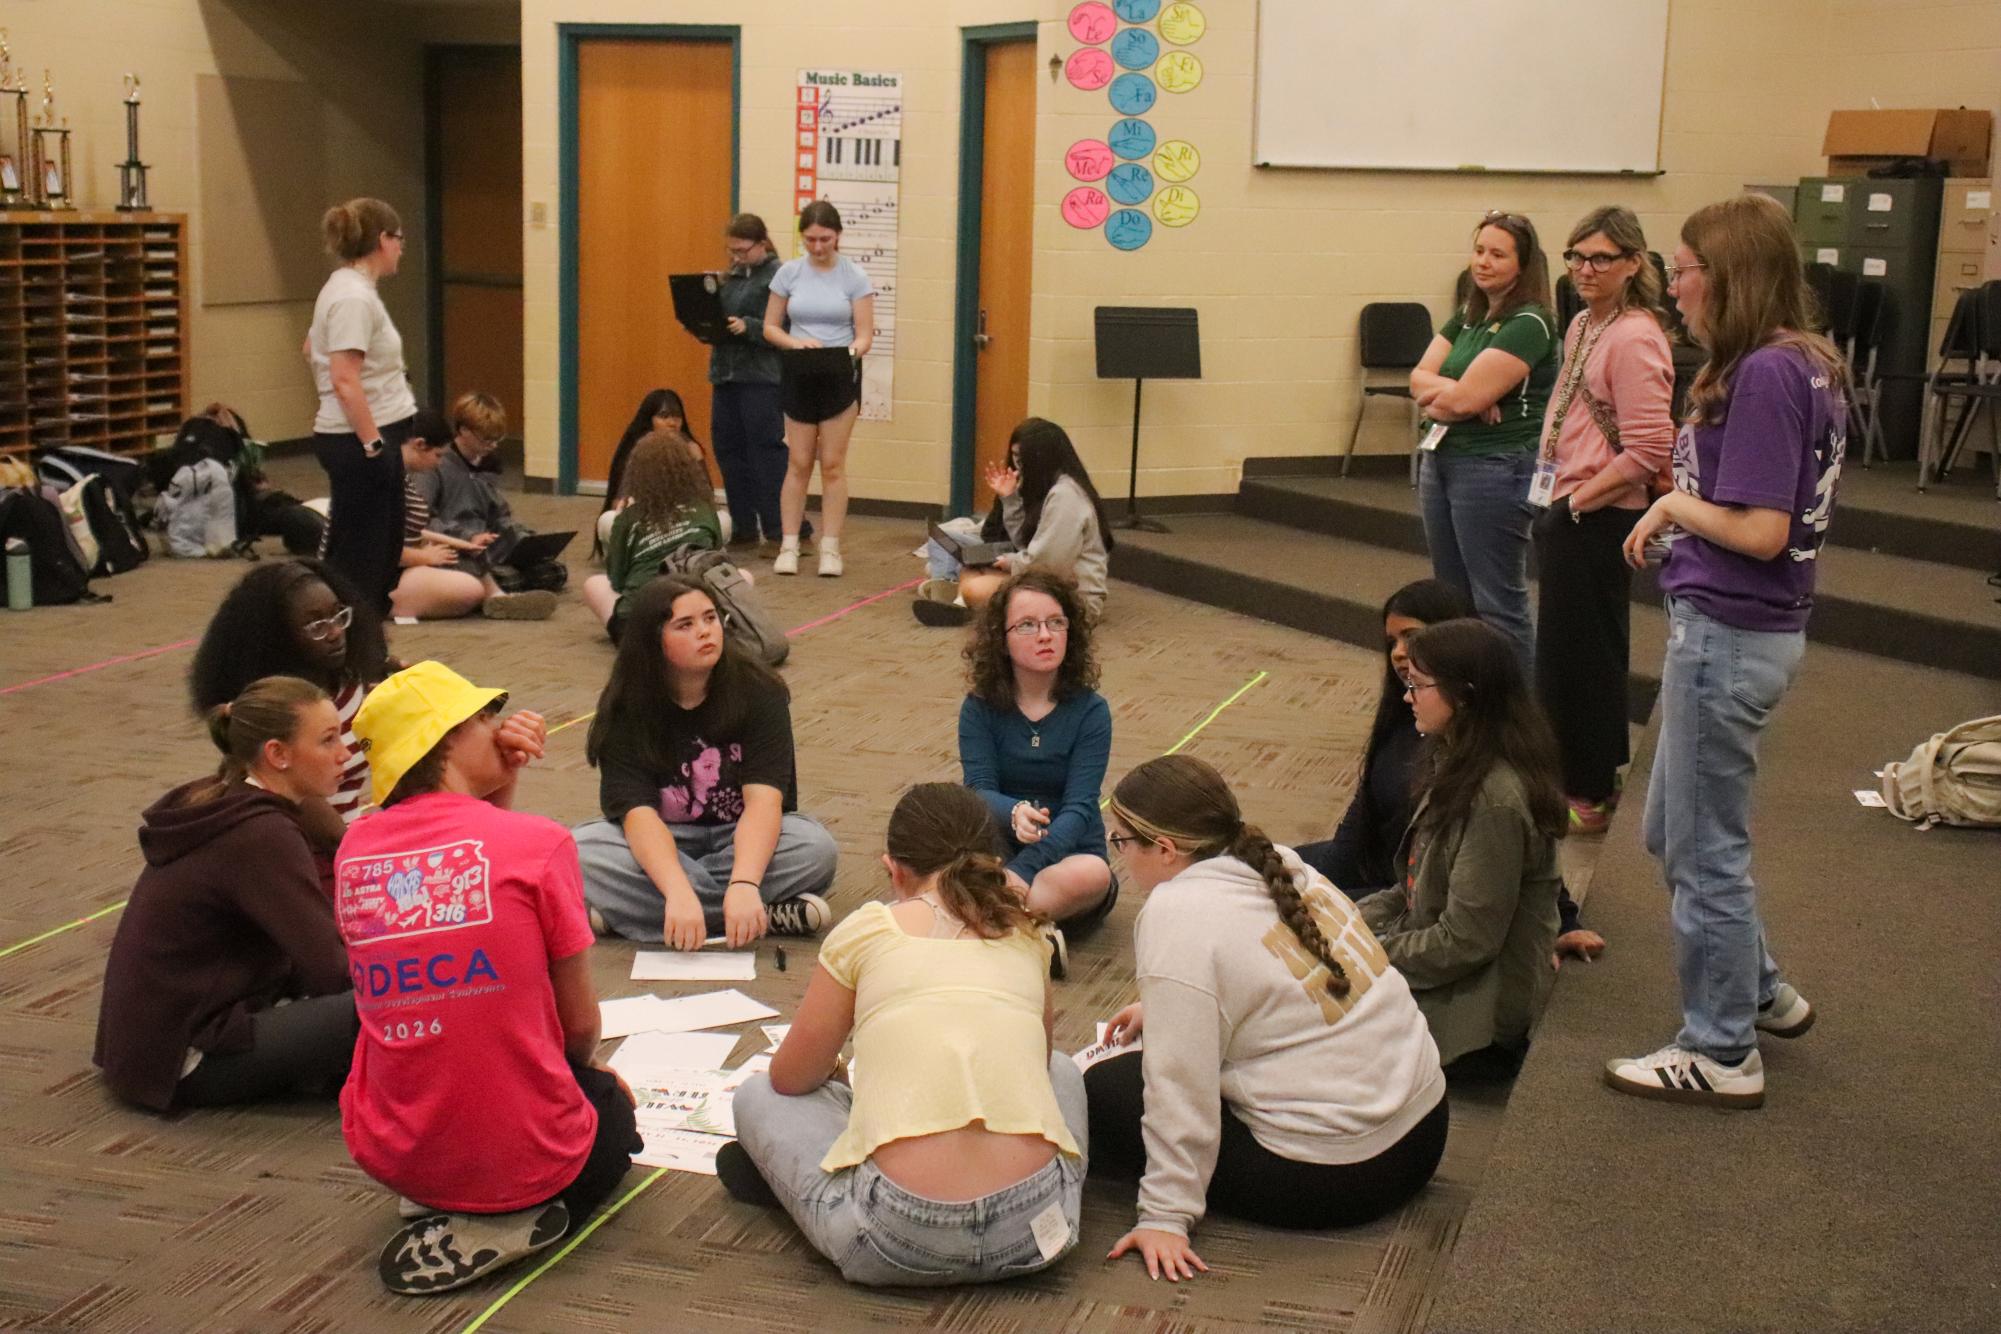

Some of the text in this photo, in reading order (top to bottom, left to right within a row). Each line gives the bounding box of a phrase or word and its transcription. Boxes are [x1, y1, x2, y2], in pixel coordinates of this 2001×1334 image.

[1129, 5, 1145, 20] La
[1128, 31, 1146, 43] So
[1180, 57, 1194, 71] Fi
[806, 71, 897, 87] Music Basics
[1135, 88, 1152, 102] Fa
[1123, 122, 1141, 136] Mi
[1178, 146, 1193, 161] Ri
[1074, 161, 1095, 176] Me
[1131, 167, 1149, 182] Re
[1086, 191, 1103, 205] Ra
[1167, 188, 1184, 202] Di
[1120, 211, 1141, 225] Do
[361, 859, 394, 880] 785
[452, 865, 482, 896] 913
[432, 903, 466, 923] 316
[369, 948, 498, 998] DECA
[383, 1018, 443, 1041] 2026
